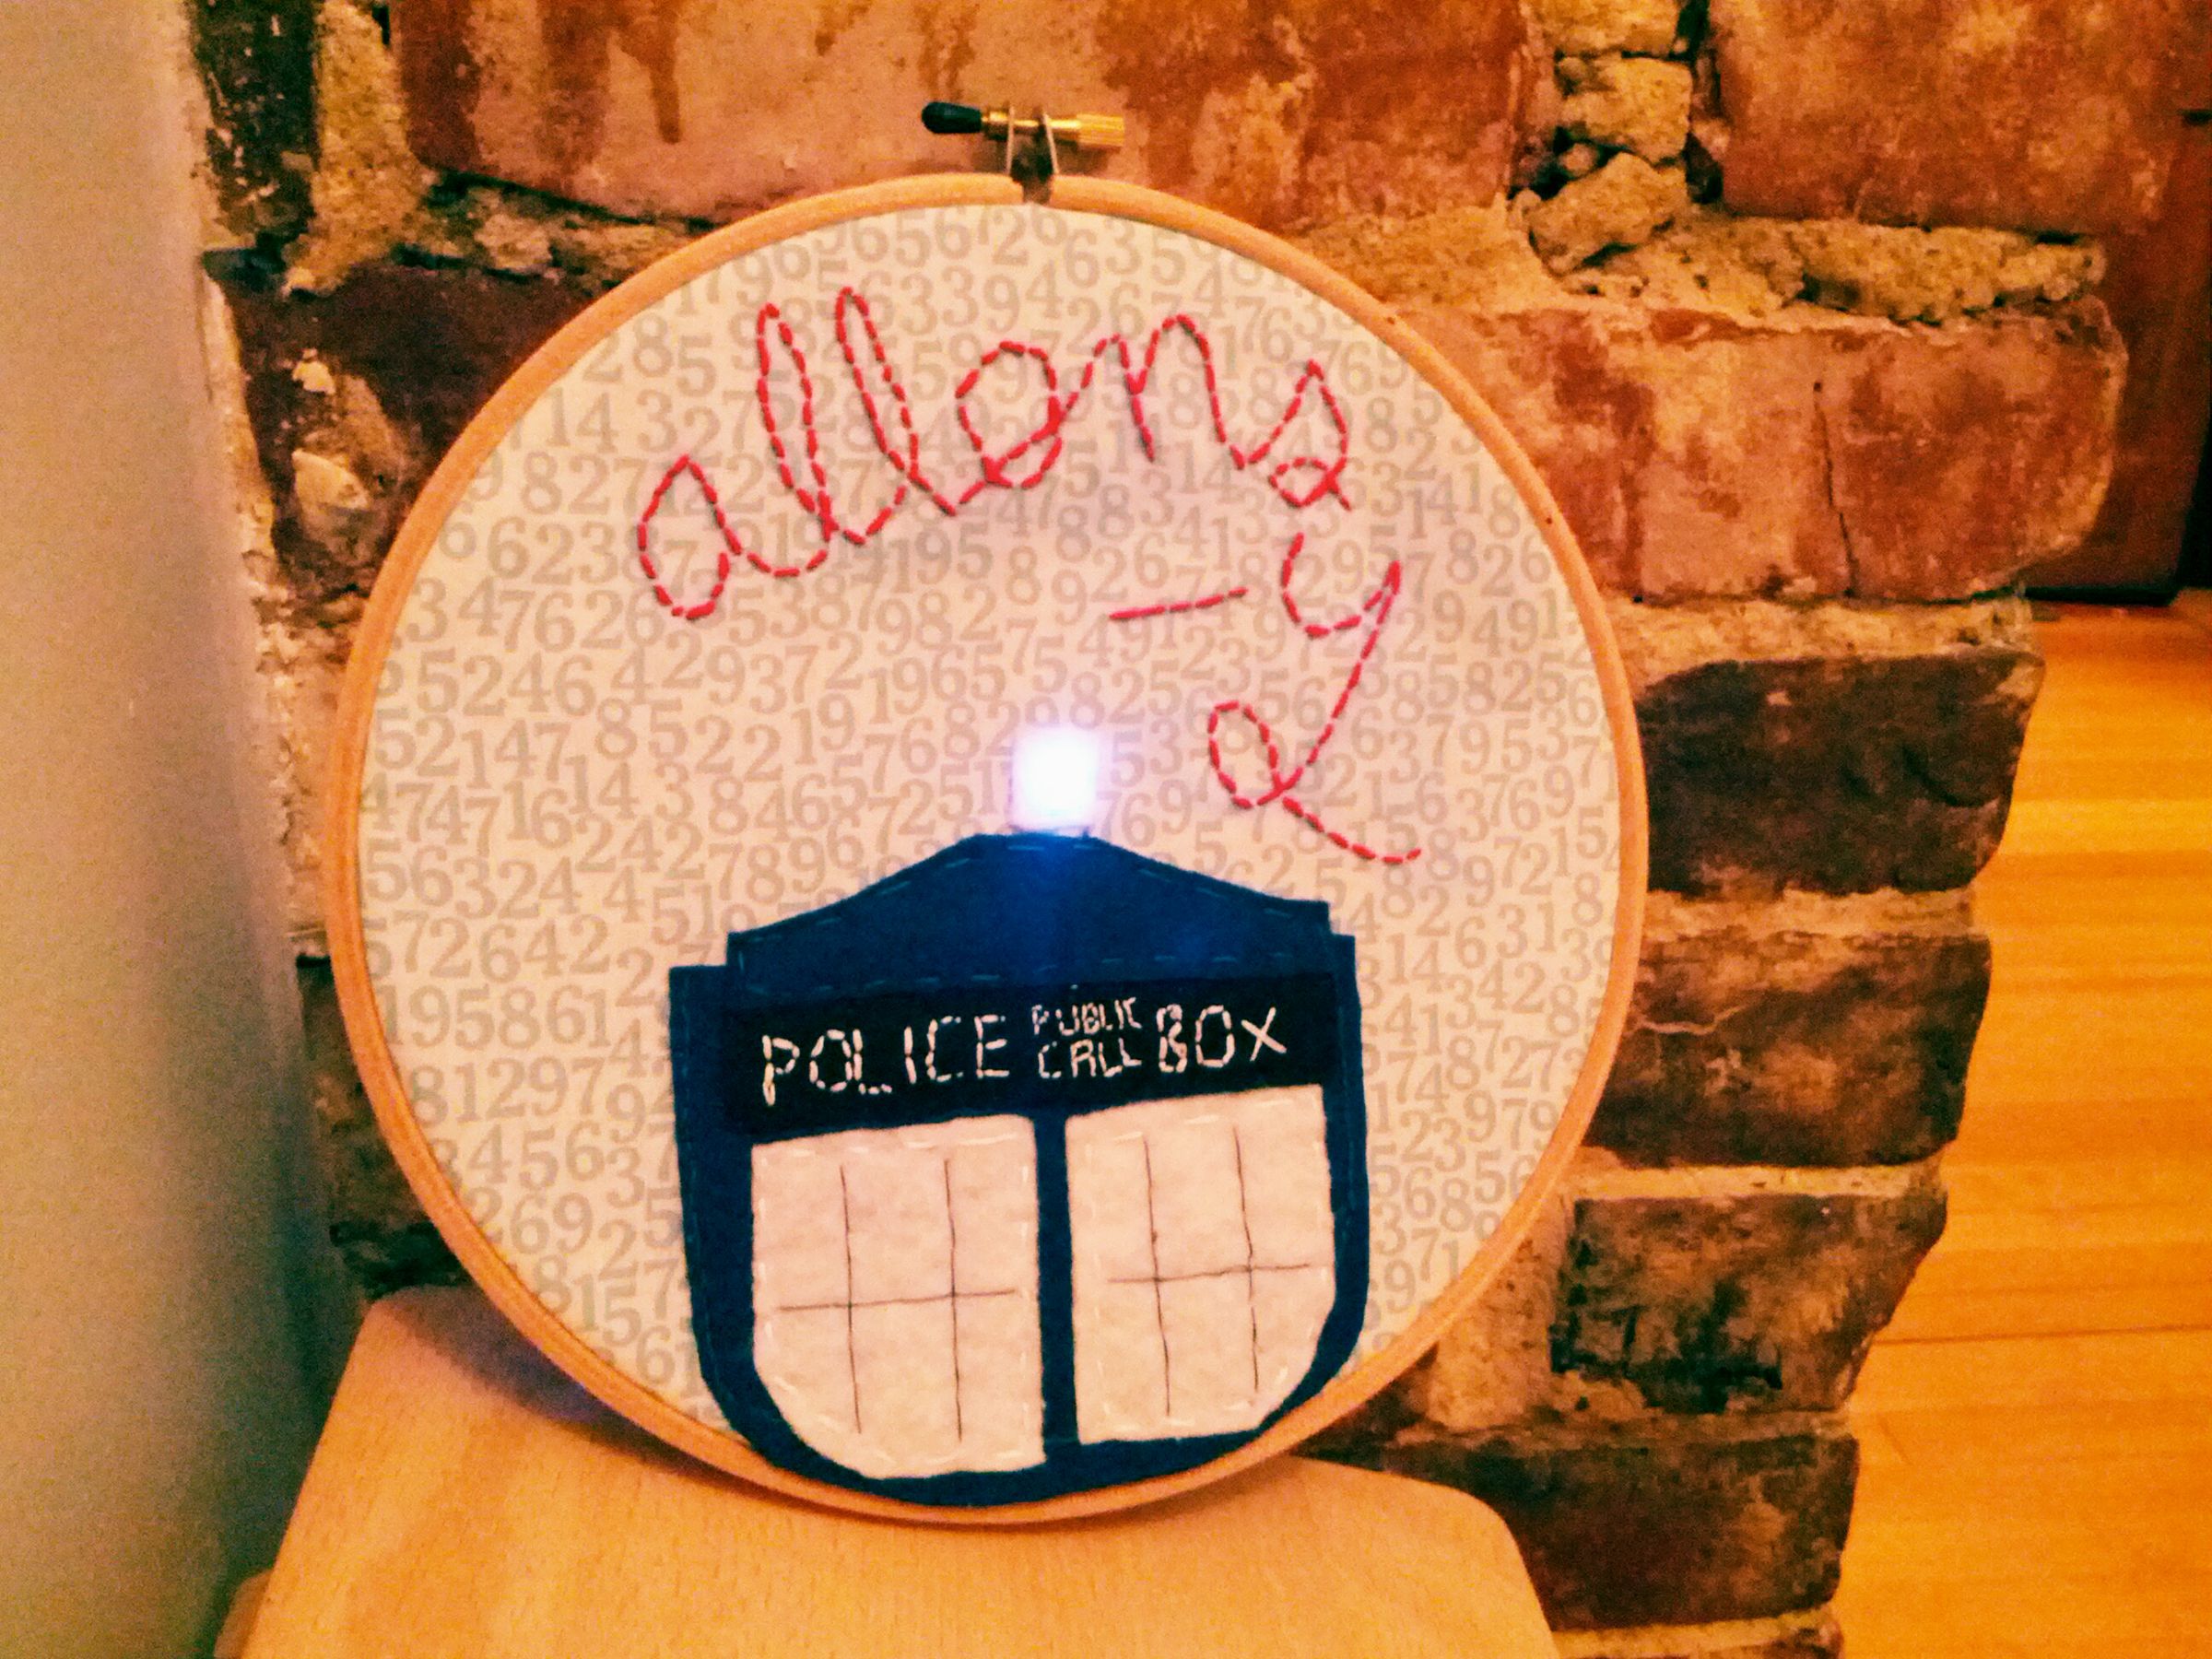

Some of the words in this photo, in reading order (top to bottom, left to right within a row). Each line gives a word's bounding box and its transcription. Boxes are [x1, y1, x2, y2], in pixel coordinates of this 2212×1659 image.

[1030, 996, 1143, 1036] PUBLIC
[1157, 1004, 1288, 1074] BOX
[761, 1014, 1010, 1106] POLICE
[1038, 1037, 1143, 1079] CALL
